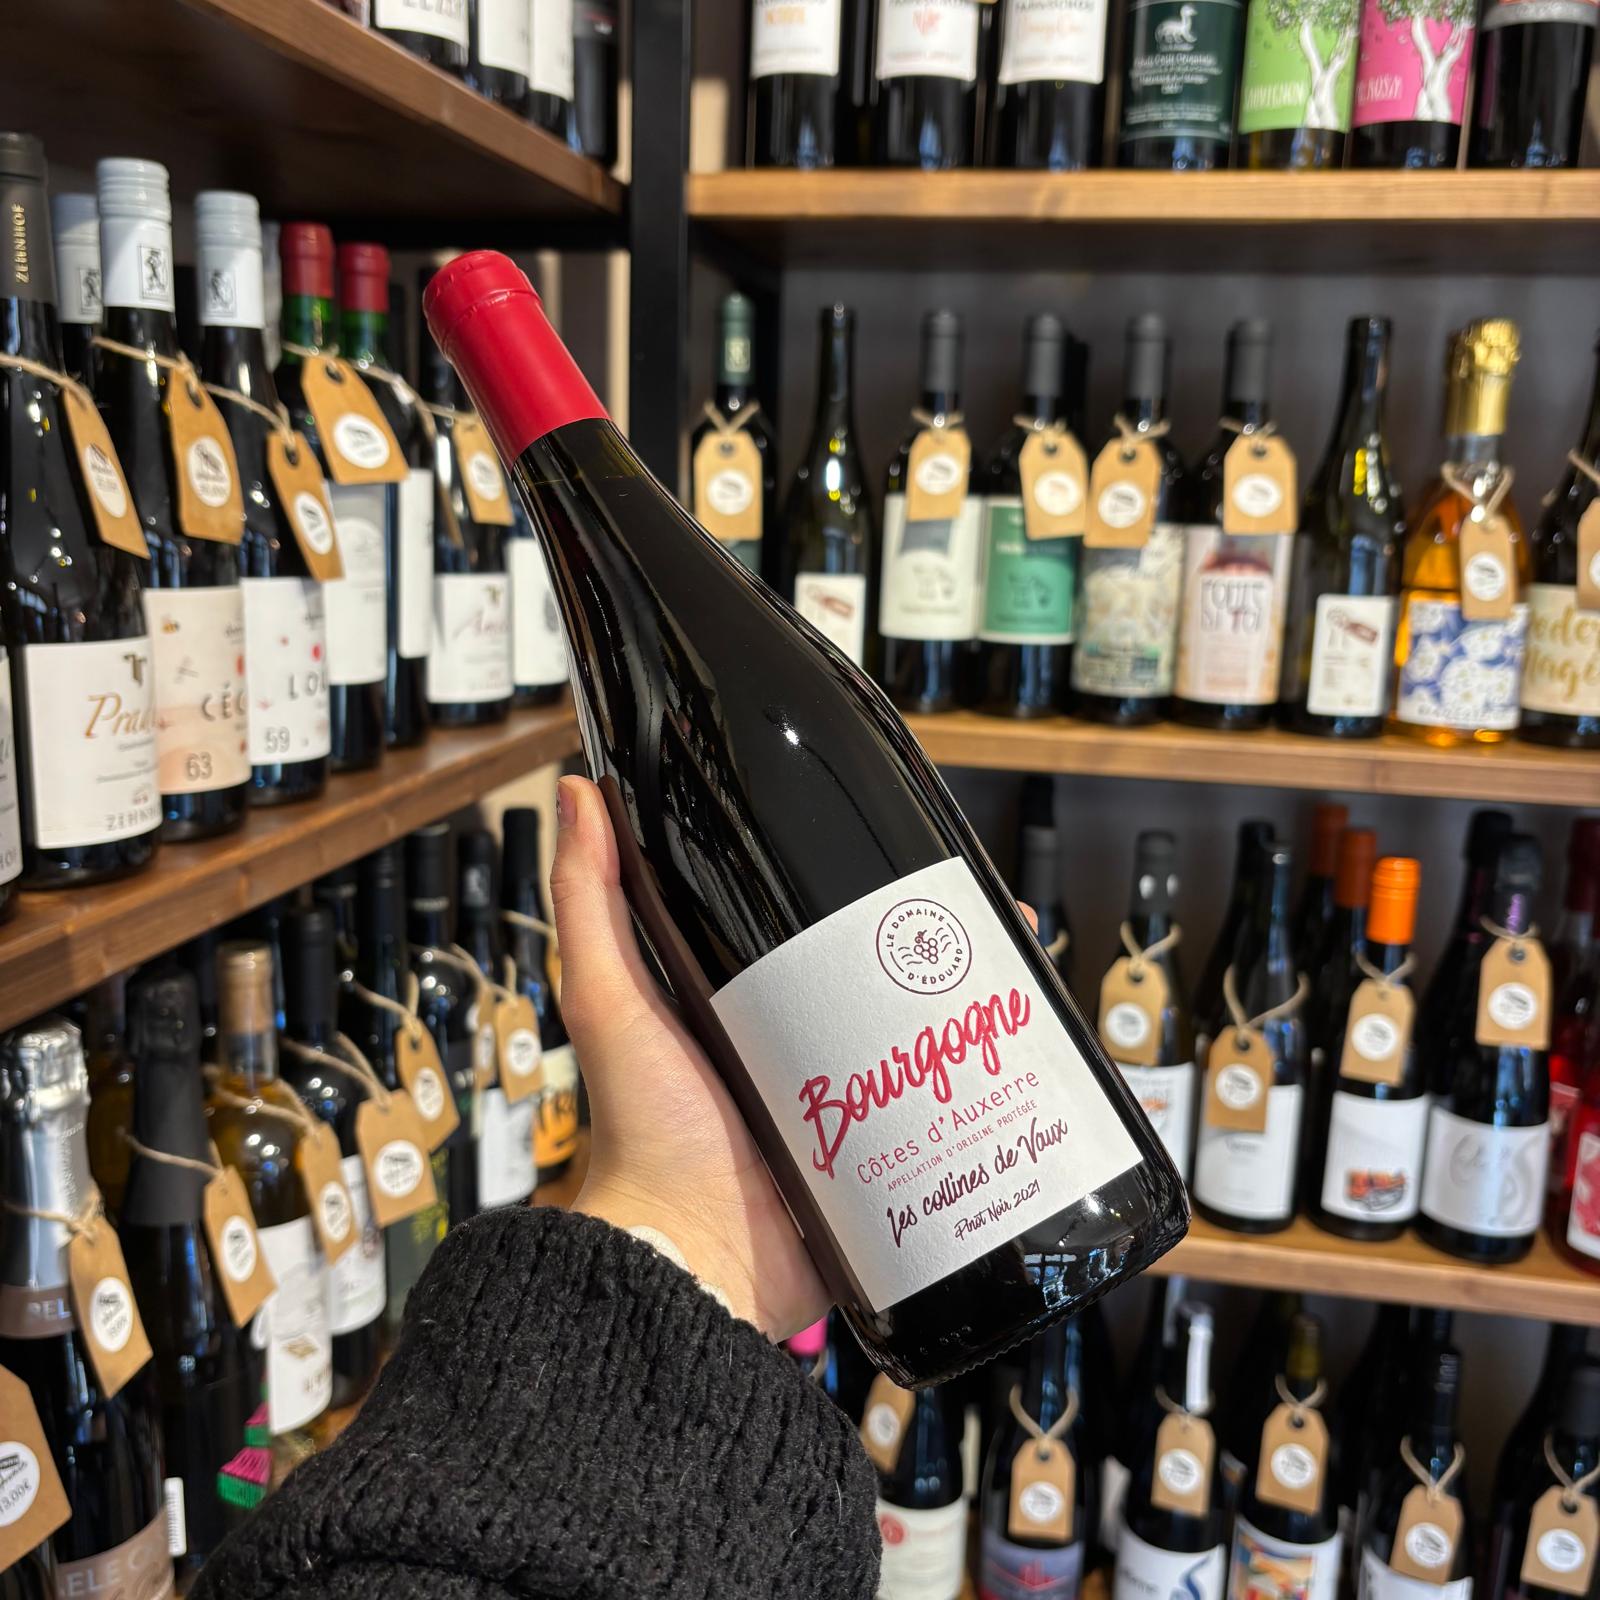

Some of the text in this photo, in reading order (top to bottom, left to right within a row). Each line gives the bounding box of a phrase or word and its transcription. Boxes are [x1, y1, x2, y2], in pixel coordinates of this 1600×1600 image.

[185, 751, 213, 781] 63
[264, 726, 291, 754] 59
[886, 908, 963, 985] LE DOMAINE D'ÉDOUARD
[799, 987, 1031, 1180] Bourgogne
[856, 1071, 1040, 1185] Côtes d'Auxerre
[887, 1153, 943, 1192] APPELLATION
[946, 1126, 995, 1158] D'ORIGINE
[886, 1116, 1068, 1248] Les collines de Vaux
[954, 1178, 1041, 1241] Pinot Noir 2021
